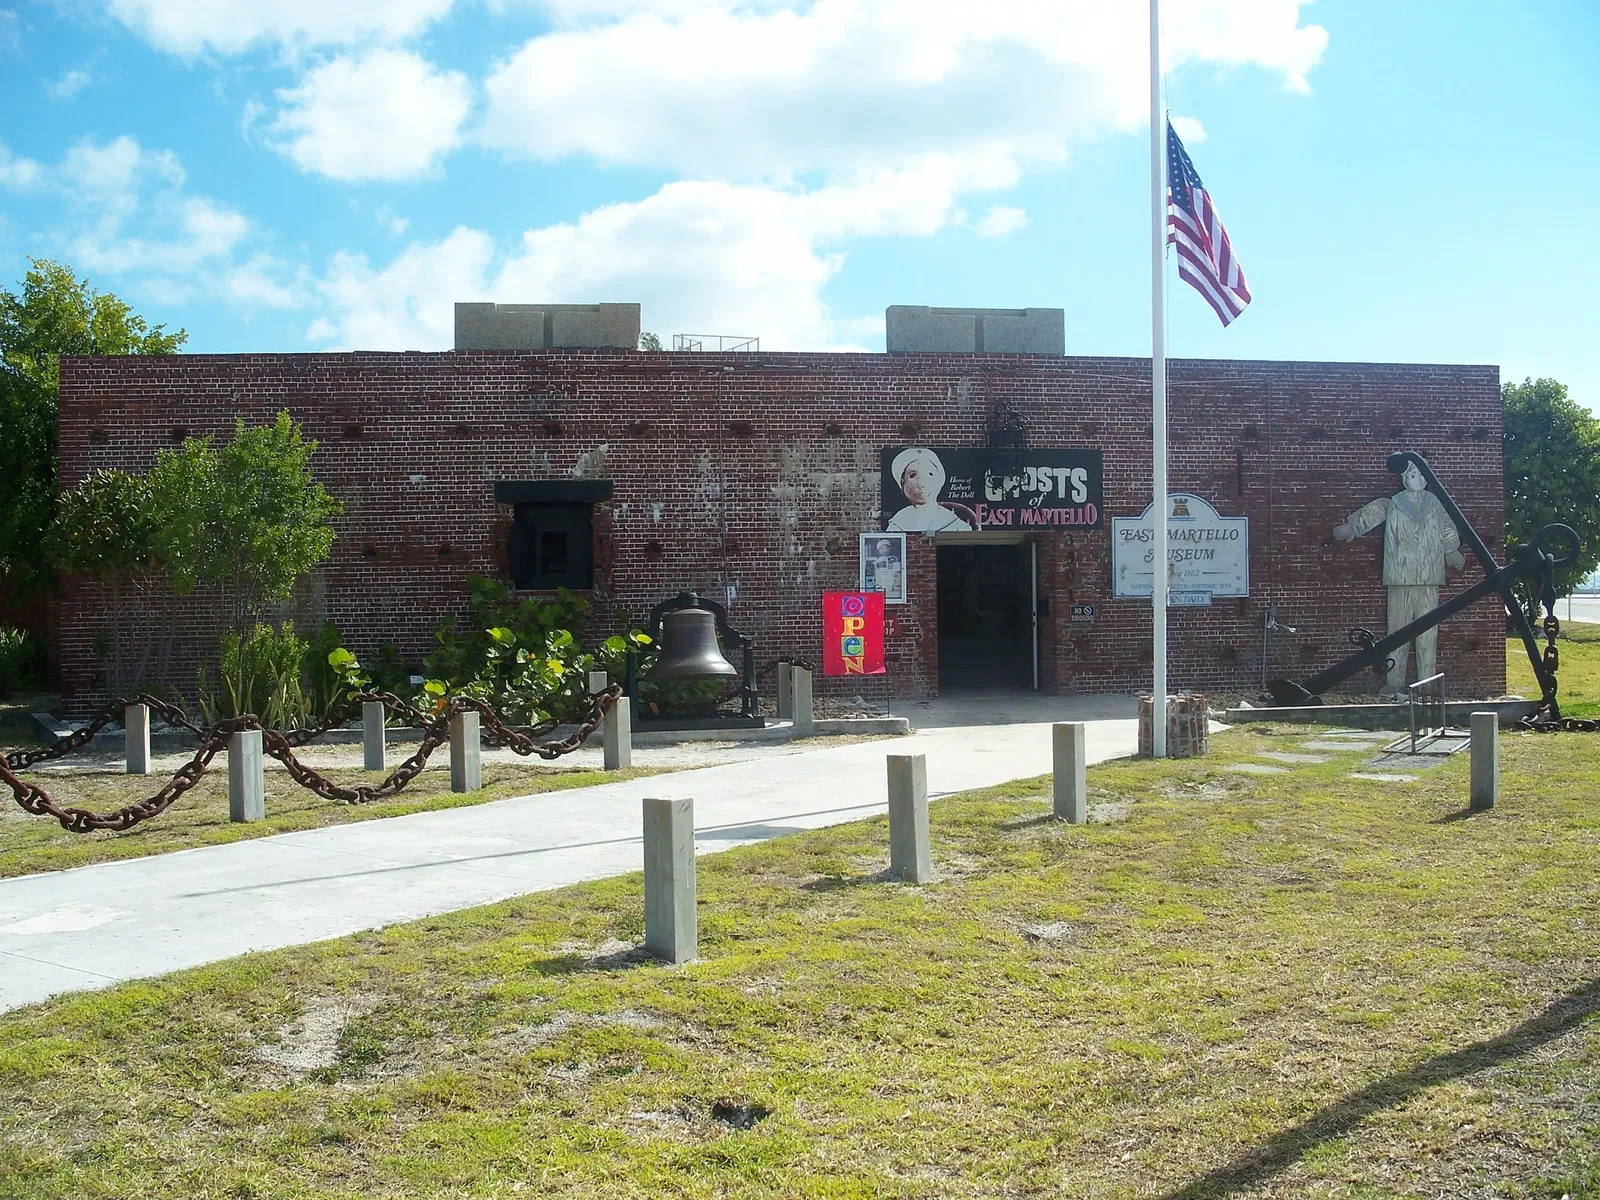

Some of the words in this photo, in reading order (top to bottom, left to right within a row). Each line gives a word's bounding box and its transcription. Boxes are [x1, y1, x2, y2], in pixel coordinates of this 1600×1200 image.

[950, 483, 971, 491] Robert
[948, 491, 960, 499] The
[960, 491, 975, 499] Doll
[1028, 492, 1048, 508] of
[974, 503, 1016, 526] EAST
[1020, 502, 1098, 526] MARTELLO
[1183, 569, 1200, 577] 1862
[1183, 595, 1207, 603] DAILY
